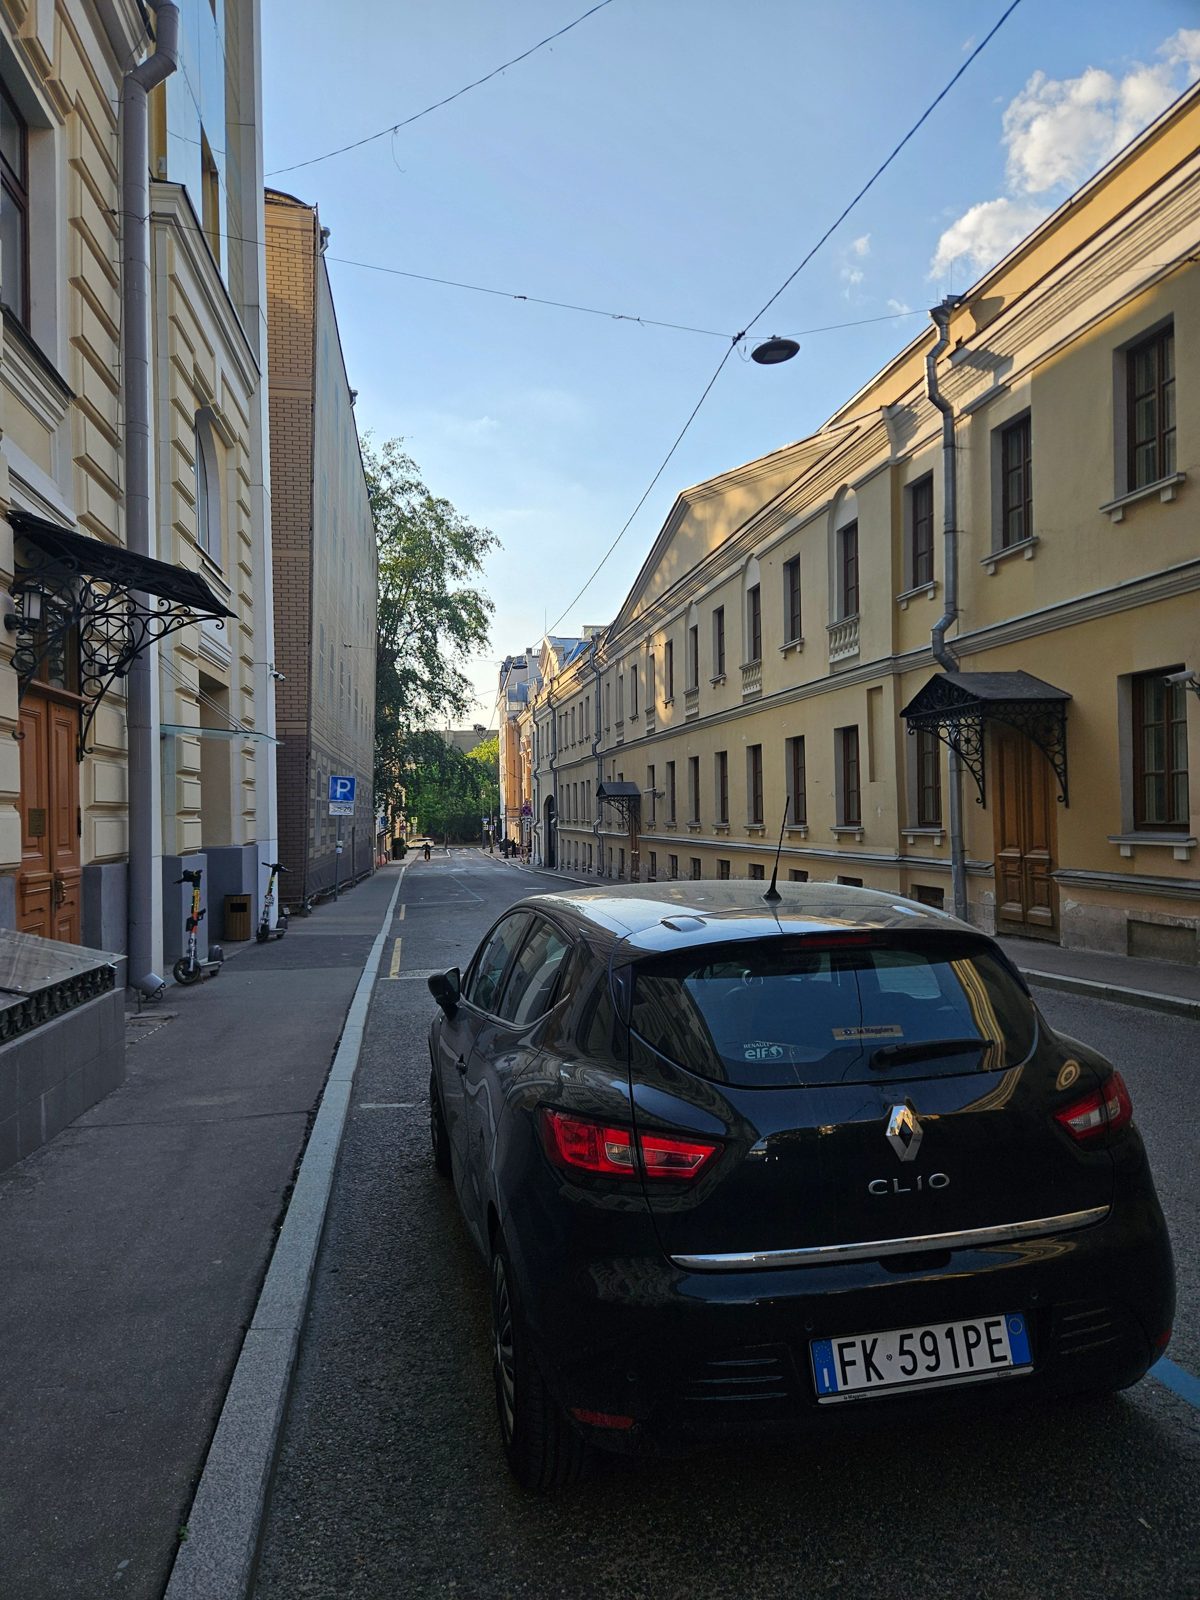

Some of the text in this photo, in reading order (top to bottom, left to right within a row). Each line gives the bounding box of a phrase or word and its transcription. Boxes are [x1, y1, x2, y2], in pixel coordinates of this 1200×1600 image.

[336, 779, 351, 799] P
[745, 1047, 769, 1059] elf
[868, 1173, 950, 1194] CLIO
[837, 1321, 1008, 1386] FK 591PE
